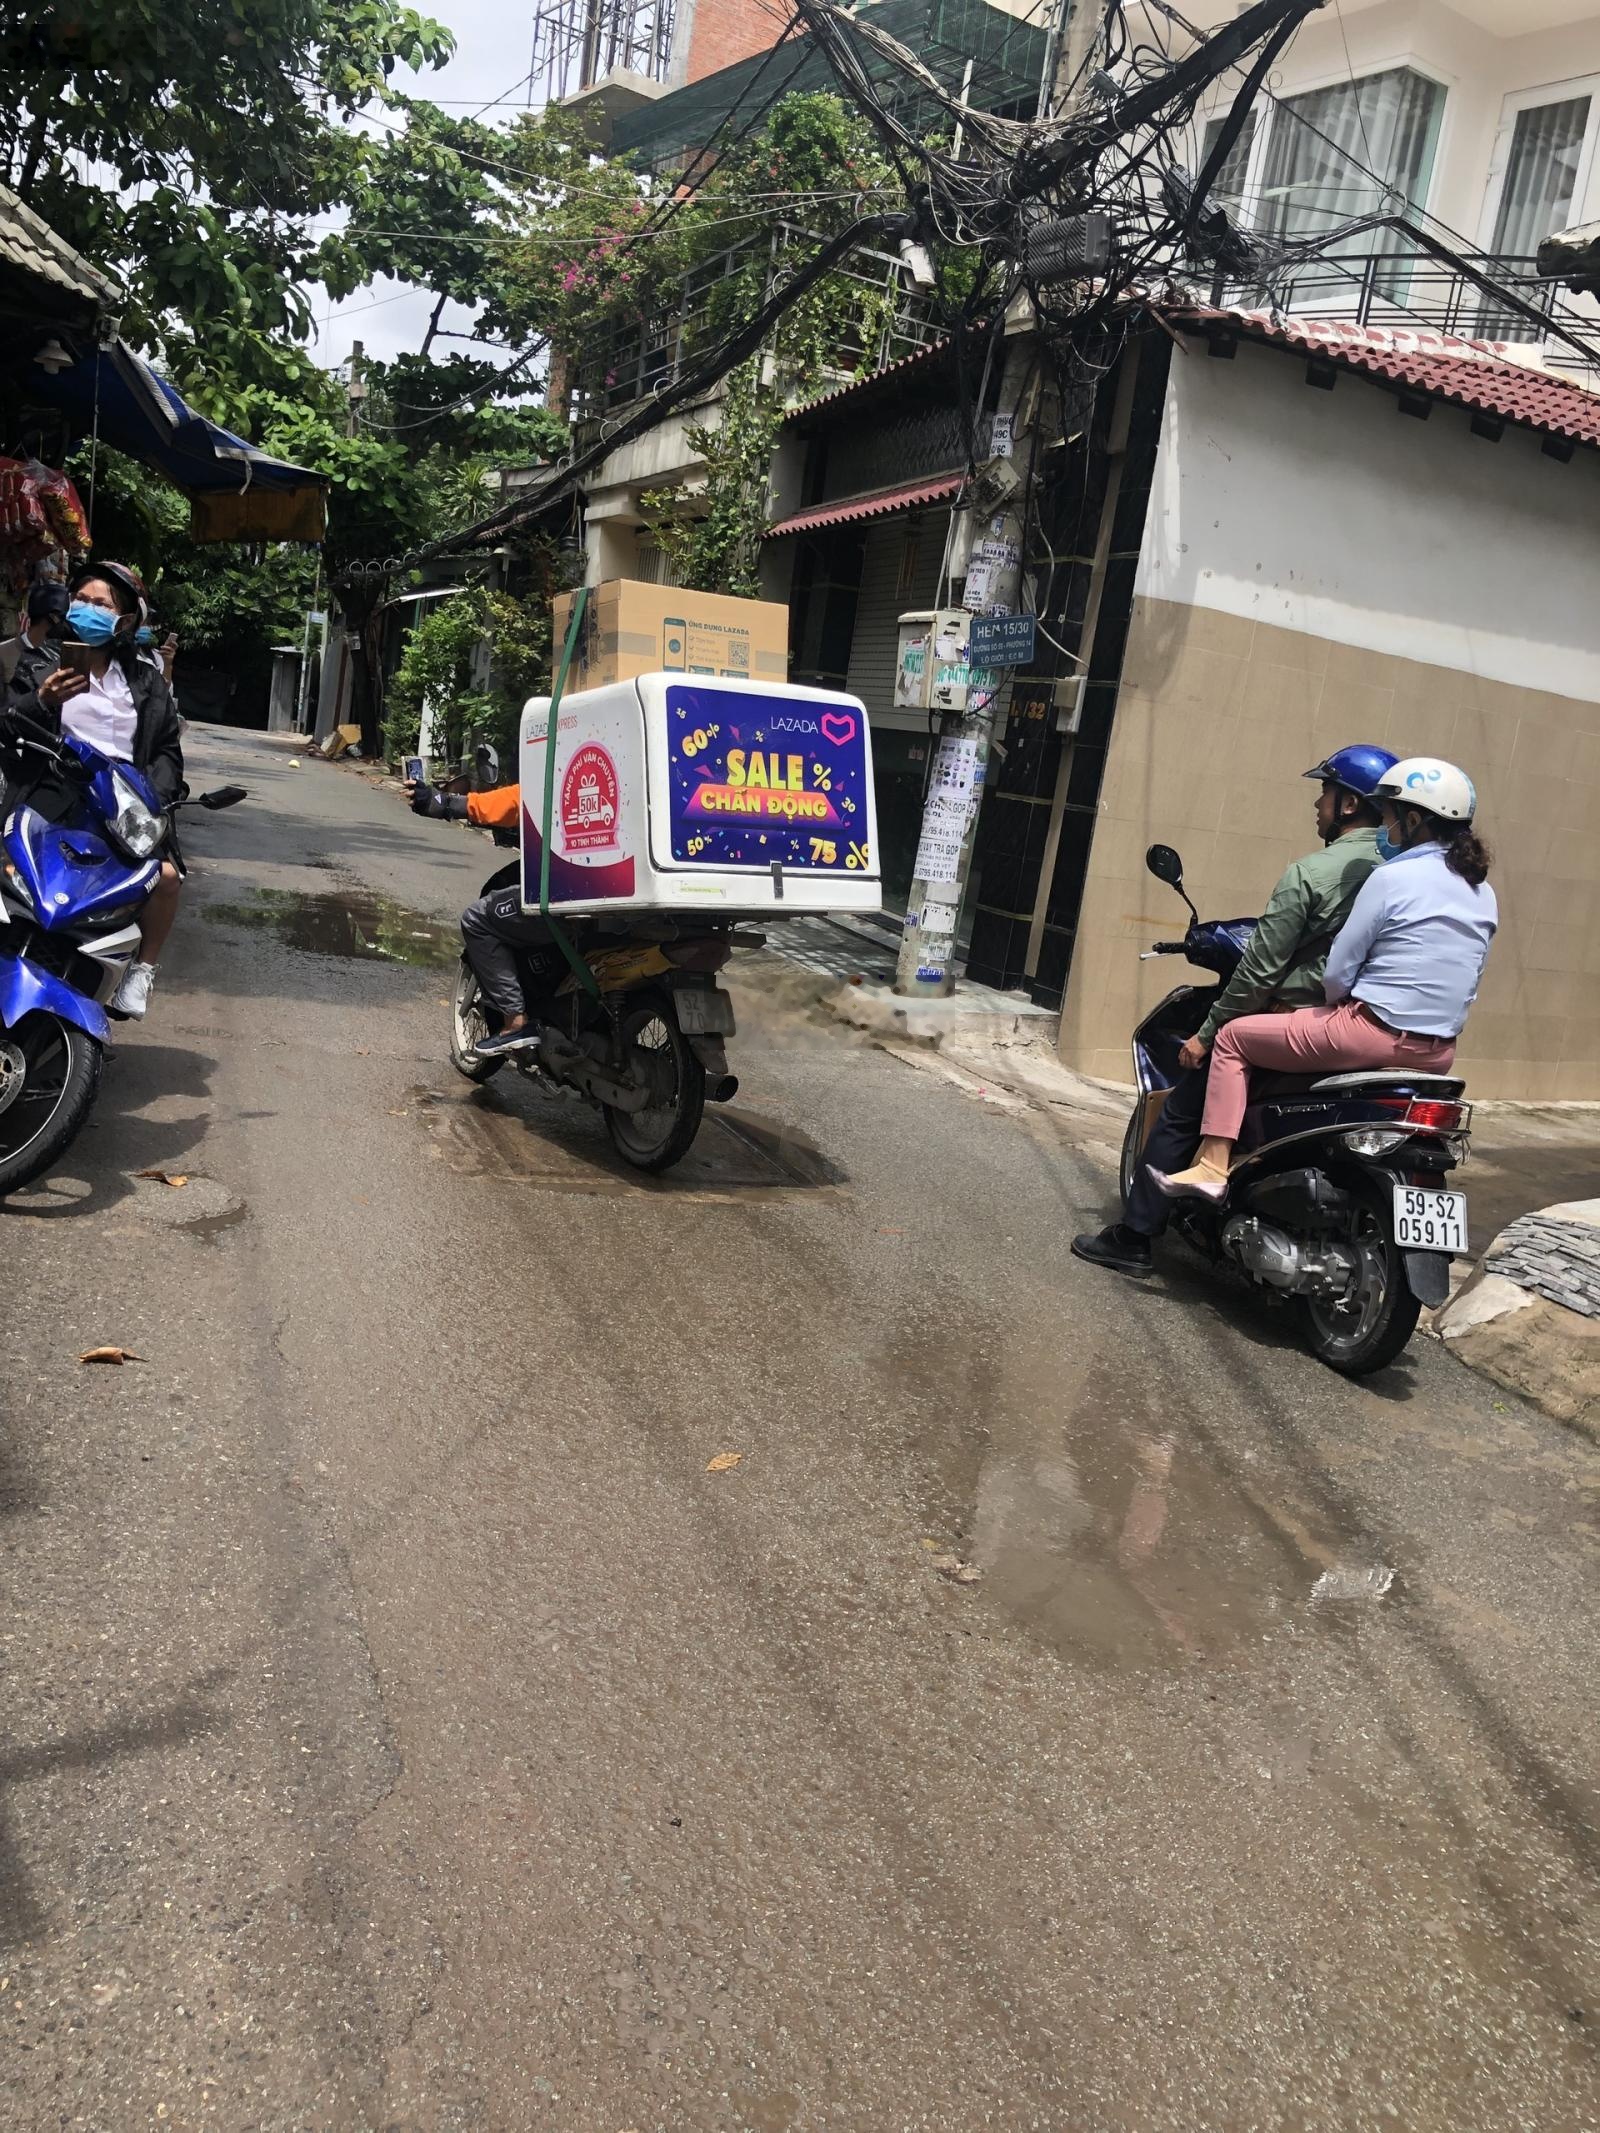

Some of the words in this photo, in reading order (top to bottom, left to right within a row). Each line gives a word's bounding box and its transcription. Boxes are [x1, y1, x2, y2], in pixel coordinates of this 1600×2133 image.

[723, 627, 750, 636] LAZADA
[1003, 621, 1029, 636] 15/30
[770, 716, 818, 734] LAZADA
[682, 723, 720, 757] 60%
[583, 751, 597, 765] VẬN
[726, 748, 804, 791] SALE
[580, 796, 597, 813] 50k
[700, 790, 761, 813] CHẤN
[766, 794, 828, 820] ĐỘNG
[841, 796, 856, 813] 30
[687, 835, 712, 857] 50%
[808, 836, 837, 864] 75
[1405, 1190, 1456, 1220] 59-S2
[1399, 1217, 1460, 1248] 059.11
